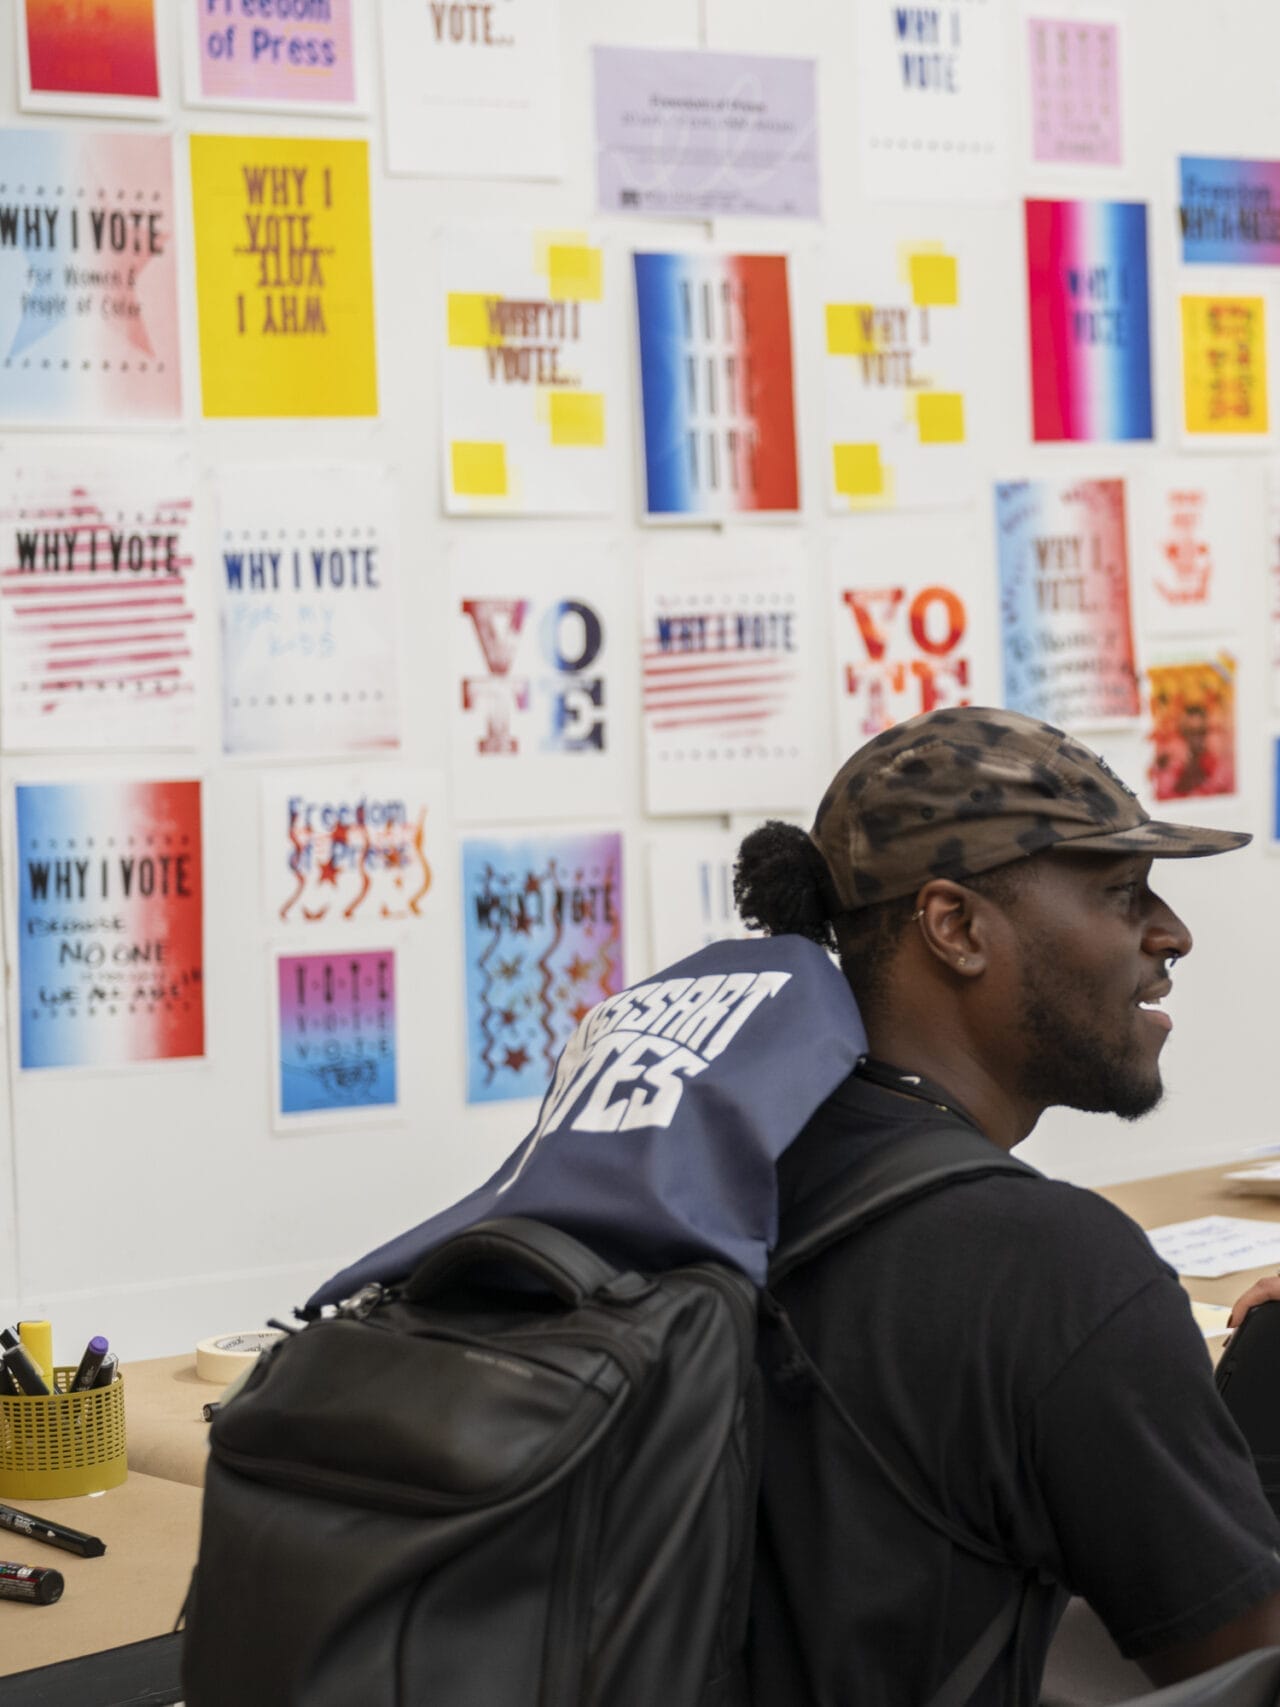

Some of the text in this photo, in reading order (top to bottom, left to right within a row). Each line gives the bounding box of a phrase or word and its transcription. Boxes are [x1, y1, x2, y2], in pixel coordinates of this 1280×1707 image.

[208, 27, 335, 65] of Press
[242, 165, 307, 206] WHY
[0, 206, 163, 255] WHY I VOTE
[17, 530, 77, 573] WHY
[110, 532, 179, 576] VOTE
[223, 546, 379, 591] WHY I VOTE
[29, 855, 191, 900] WHY I VOTE
[60, 939, 105, 970] NO
